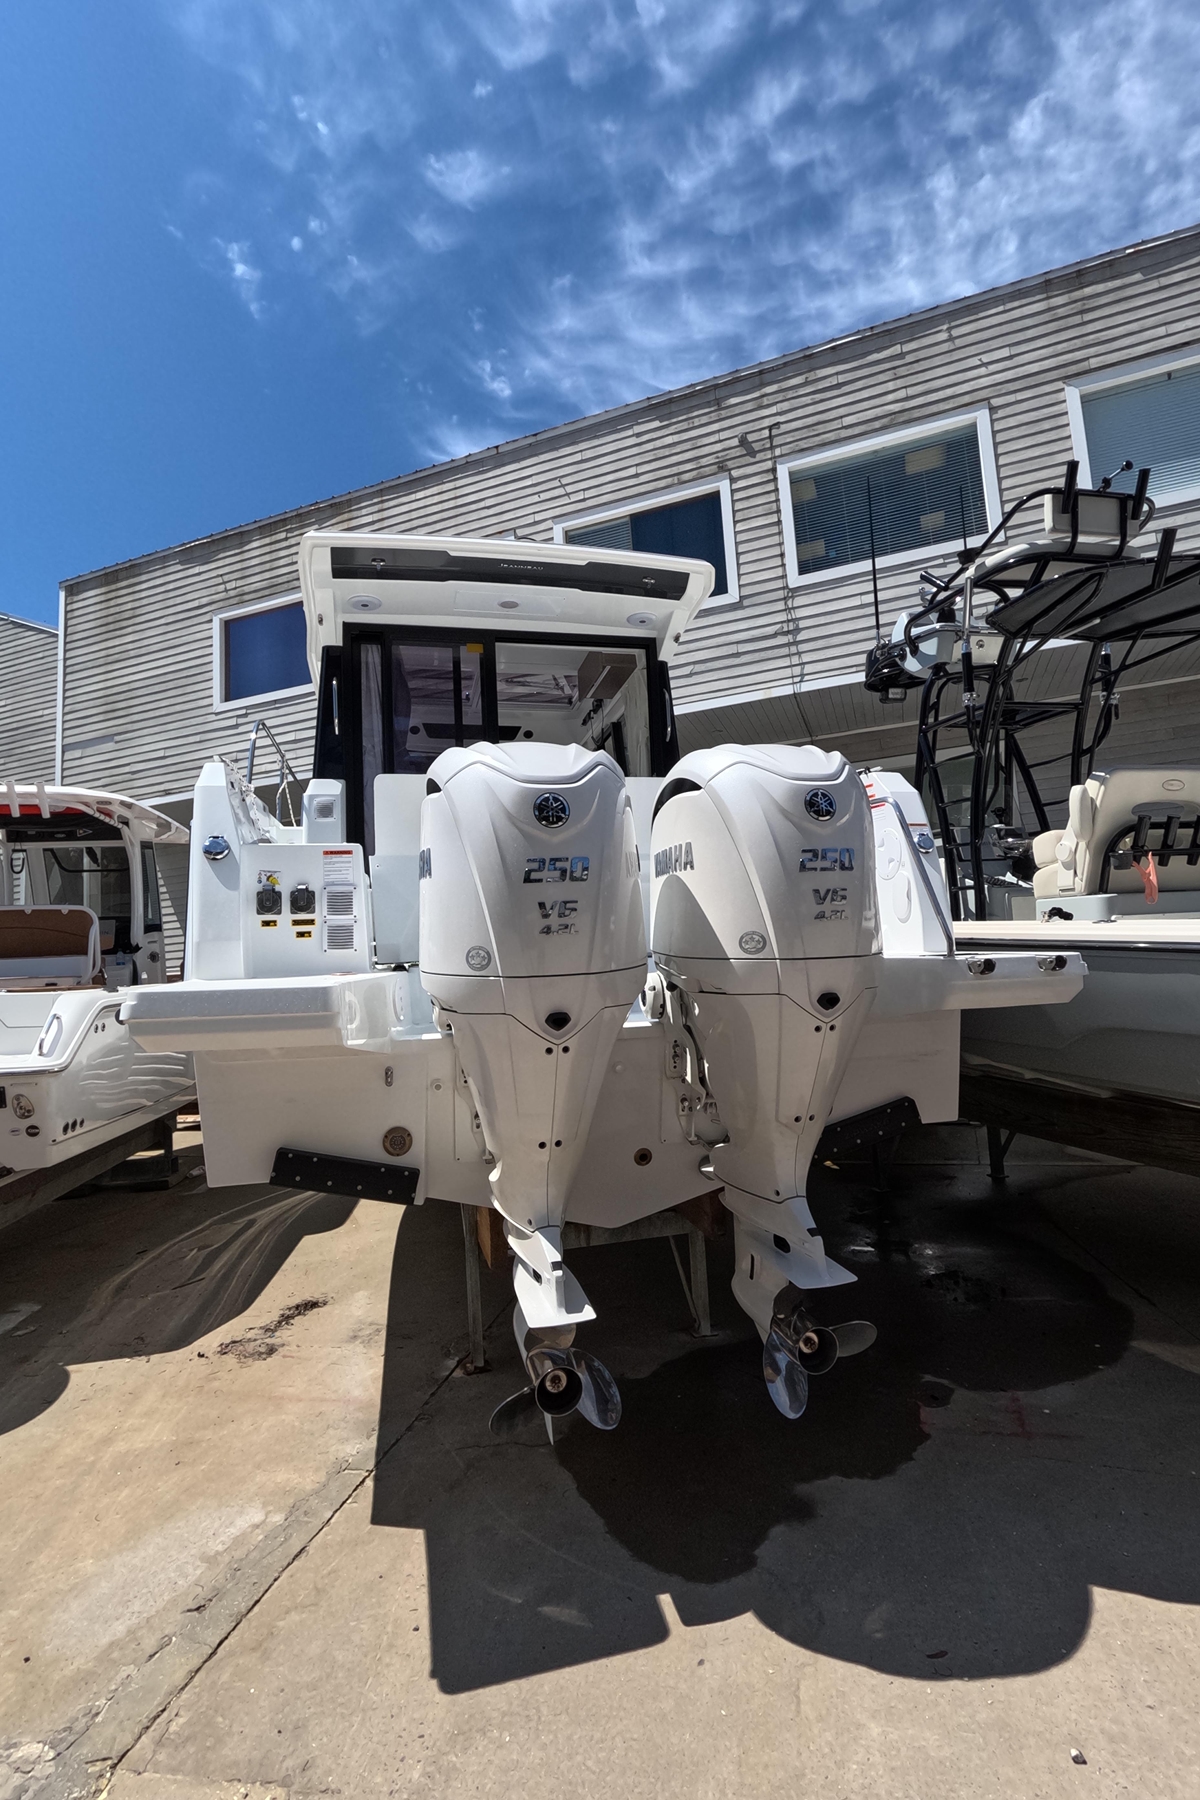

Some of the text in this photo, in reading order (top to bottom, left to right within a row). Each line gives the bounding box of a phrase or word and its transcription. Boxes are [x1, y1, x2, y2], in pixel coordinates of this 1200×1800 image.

[523, 857, 590, 883] 250
[798, 848, 855, 872] 250
[812, 888, 848, 905] V6
[538, 900, 579, 919] V6
